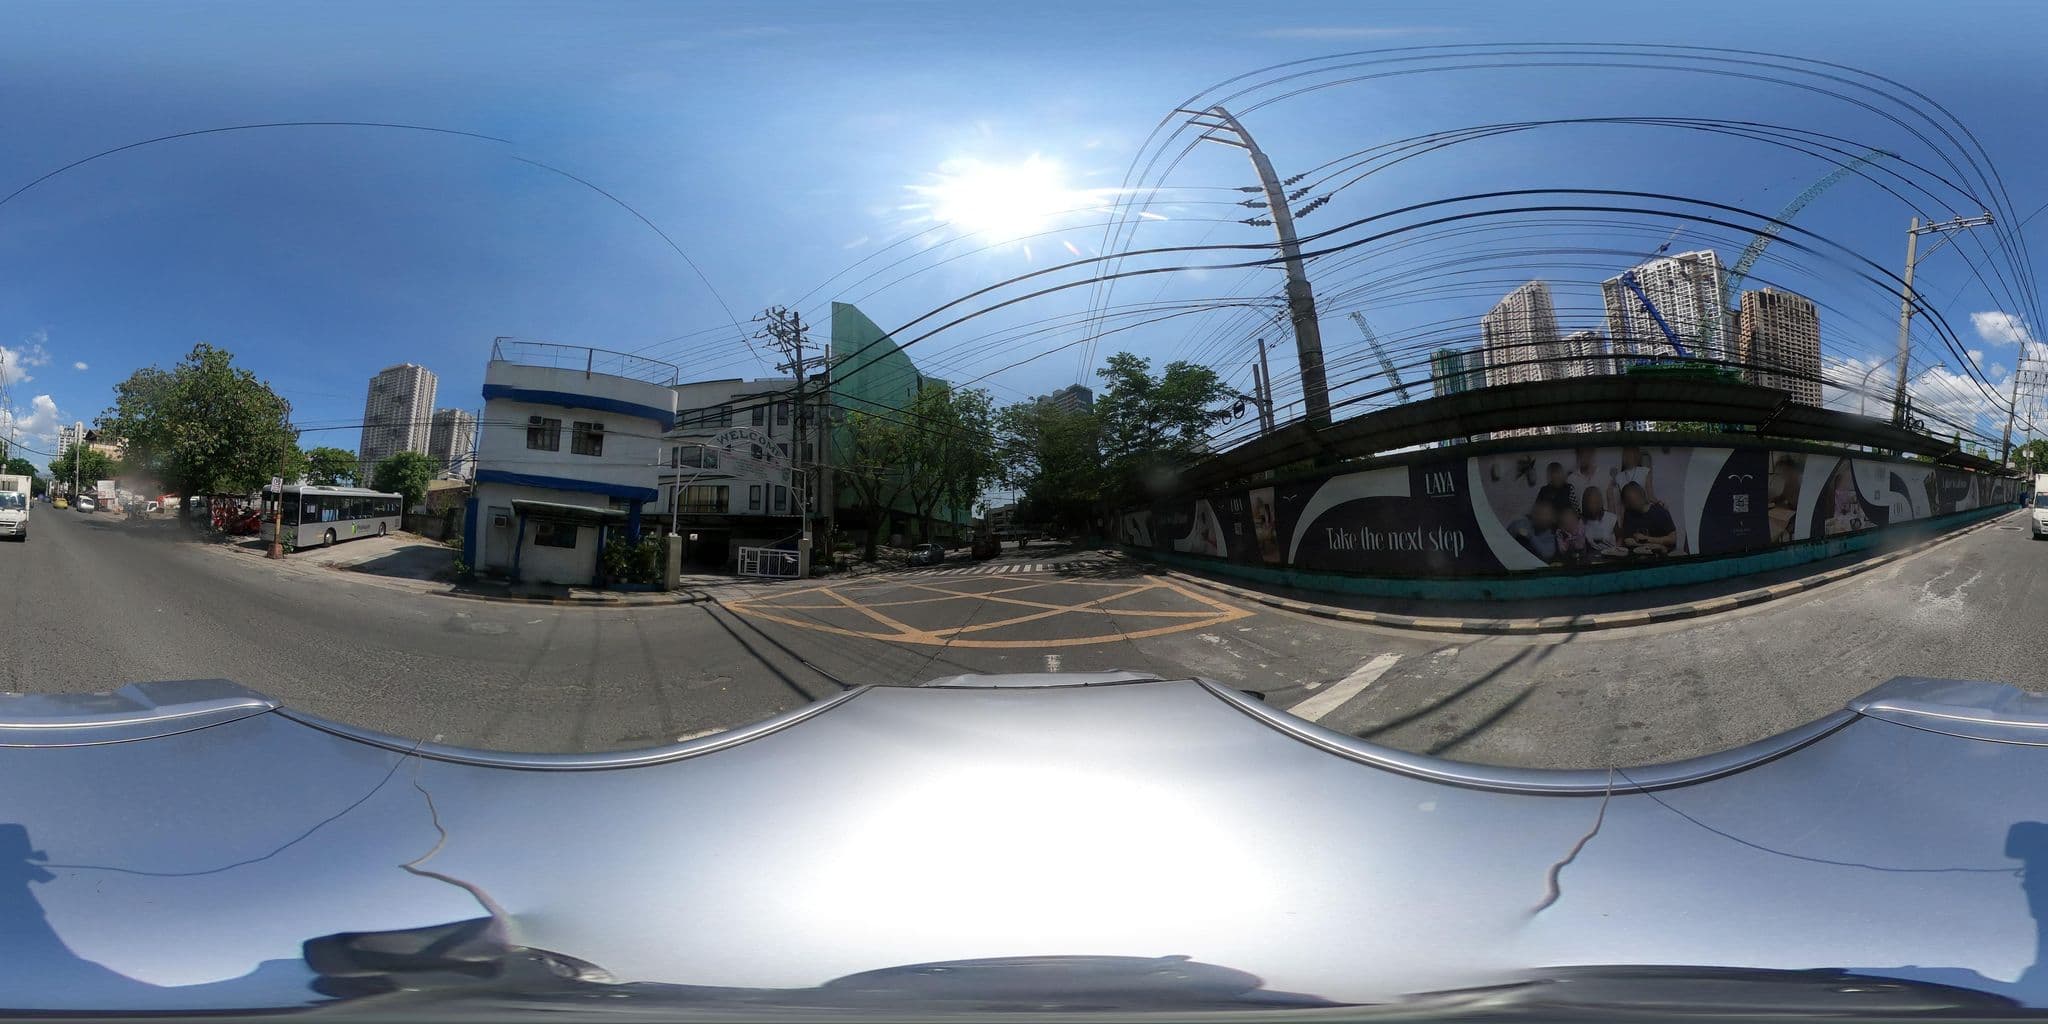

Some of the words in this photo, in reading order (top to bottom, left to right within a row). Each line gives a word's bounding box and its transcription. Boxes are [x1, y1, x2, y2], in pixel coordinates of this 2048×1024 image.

[1425, 471, 1455, 494] LAYA
[1326, 527, 1357, 550] Take
[1361, 526, 1384, 550] the
[1388, 525, 1424, 550] next
[1429, 525, 1464, 557] step
